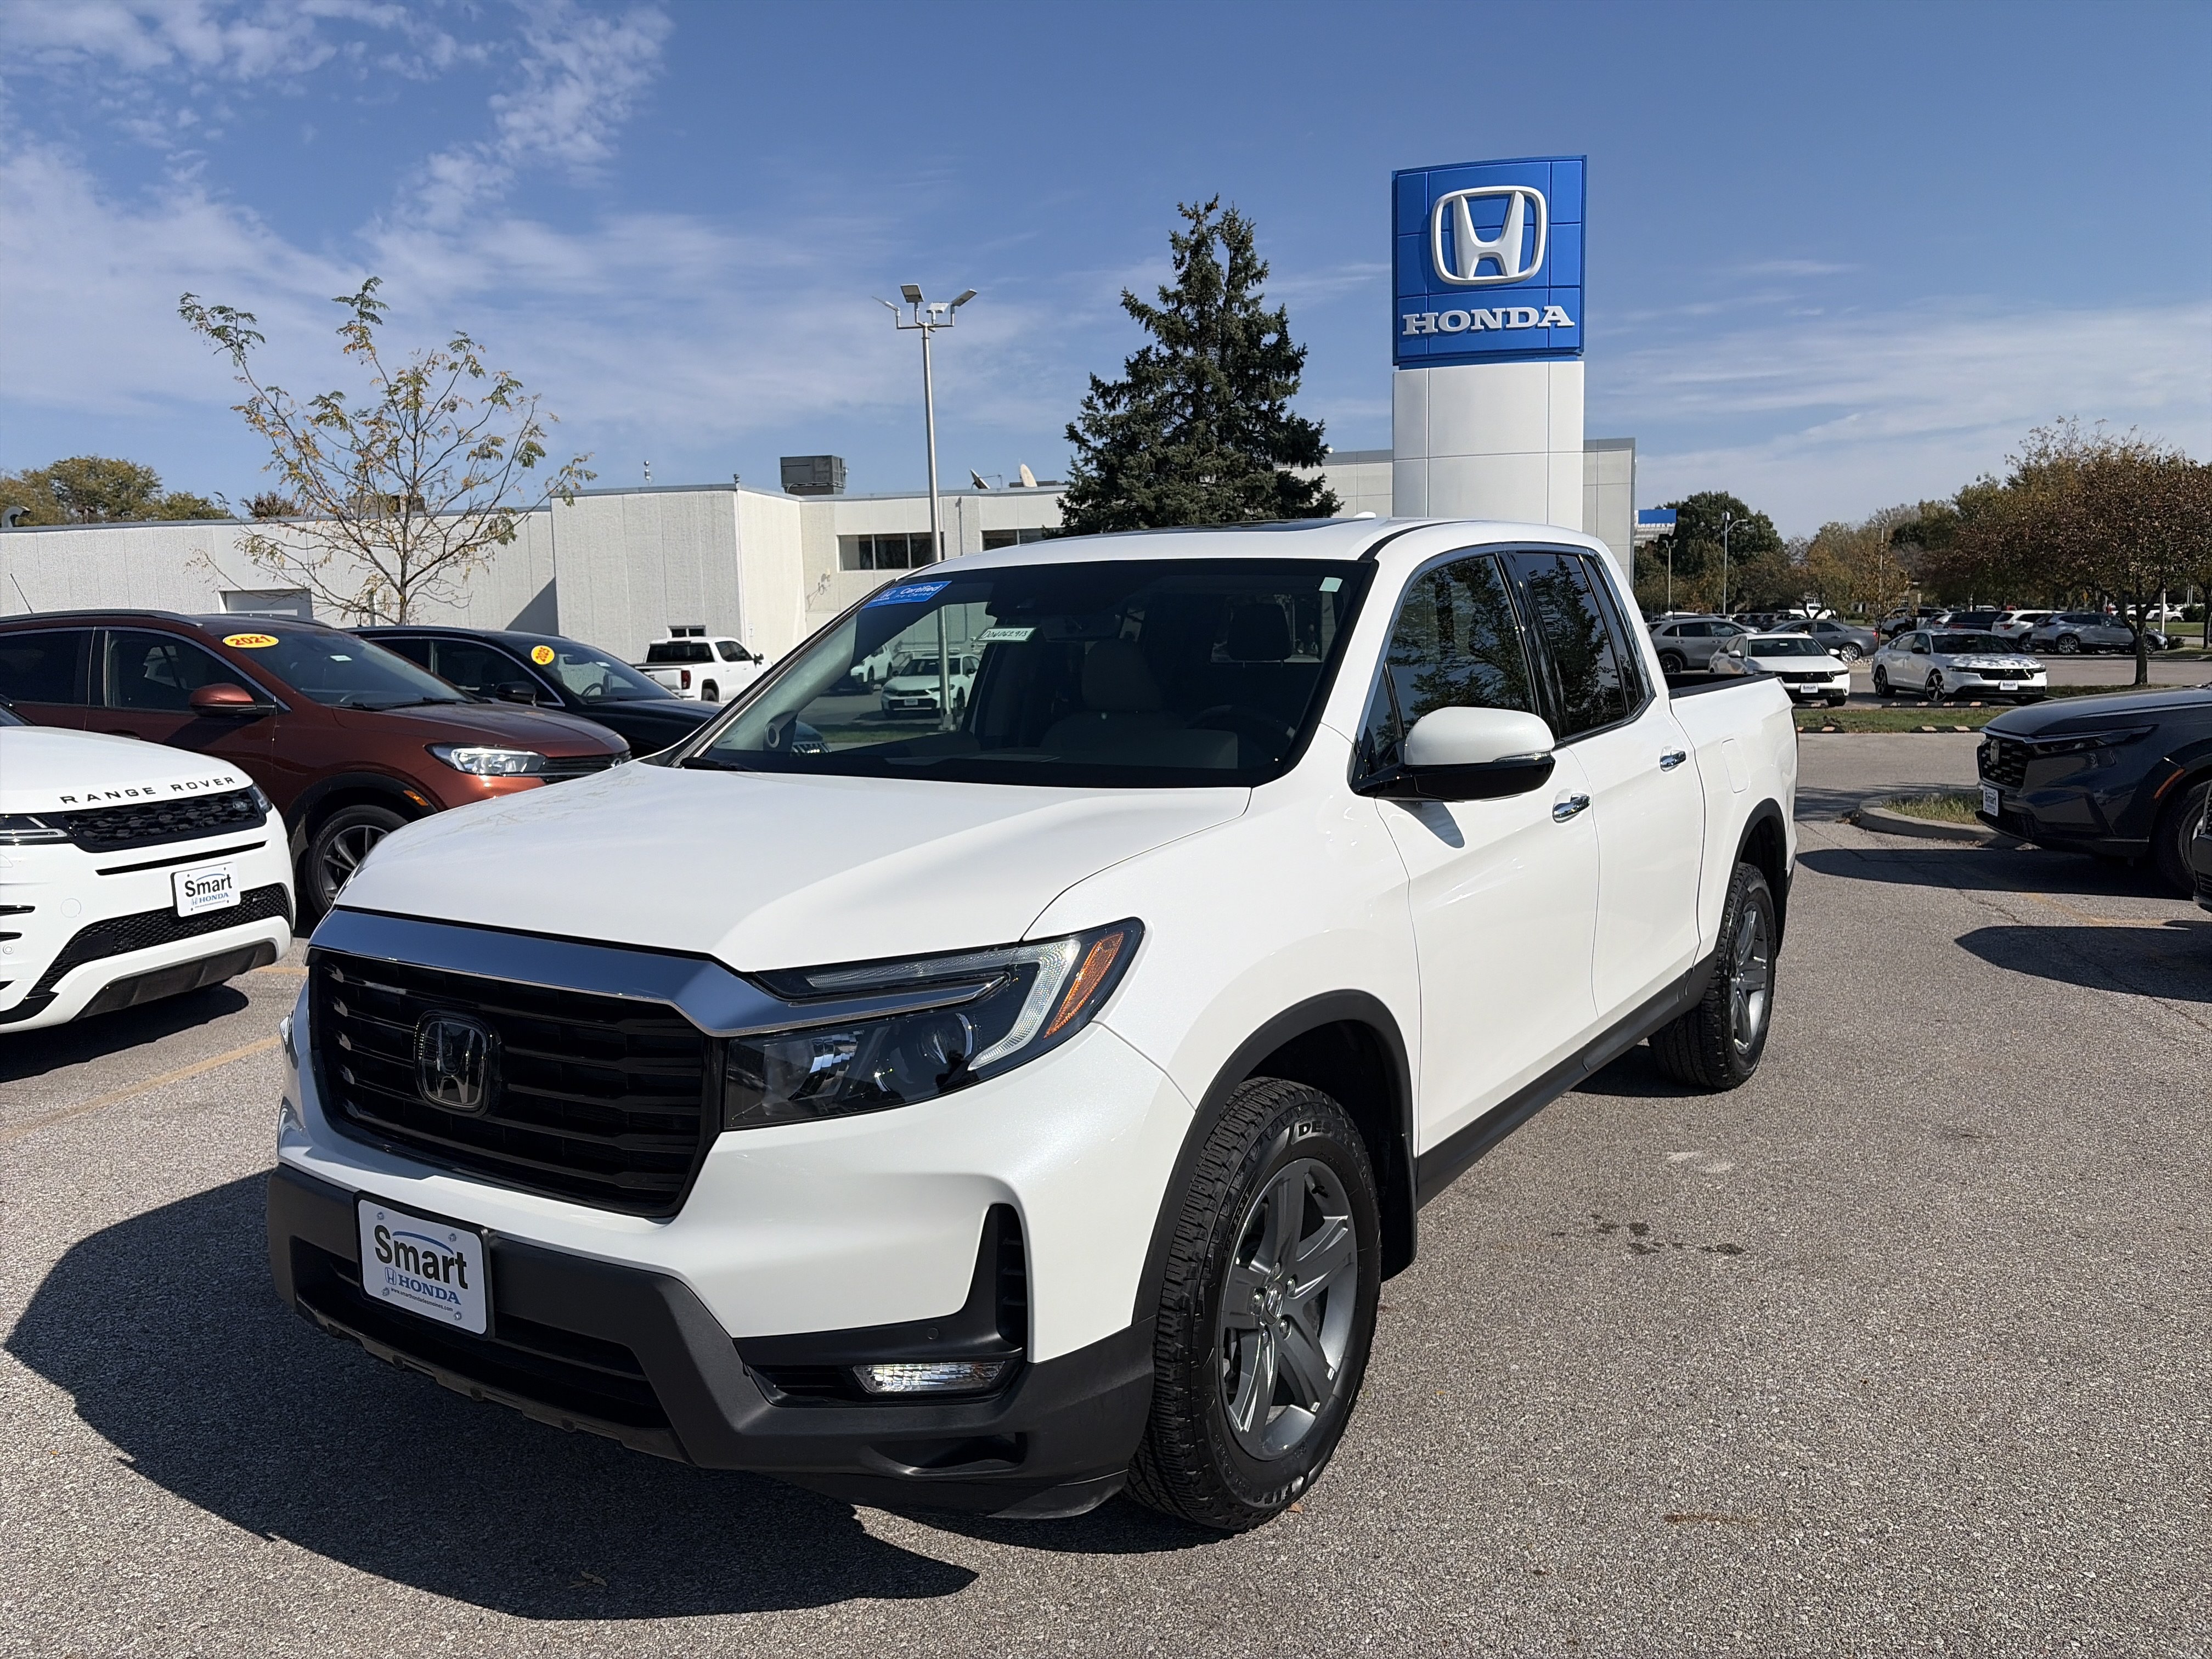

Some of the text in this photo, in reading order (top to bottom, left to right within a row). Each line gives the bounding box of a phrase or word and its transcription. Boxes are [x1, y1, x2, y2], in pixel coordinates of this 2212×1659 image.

[1403, 306, 1575, 336] HONDA
[900, 584, 943, 595] Certified
[230, 635, 270, 646] 2021
[59, 777, 235, 804] RANGE ROVER
[184, 874, 232, 897] Smart
[199, 892, 229, 903] HONDA
[374, 1224, 469, 1289] Smart
[397, 1274, 461, 1305] HONDA
